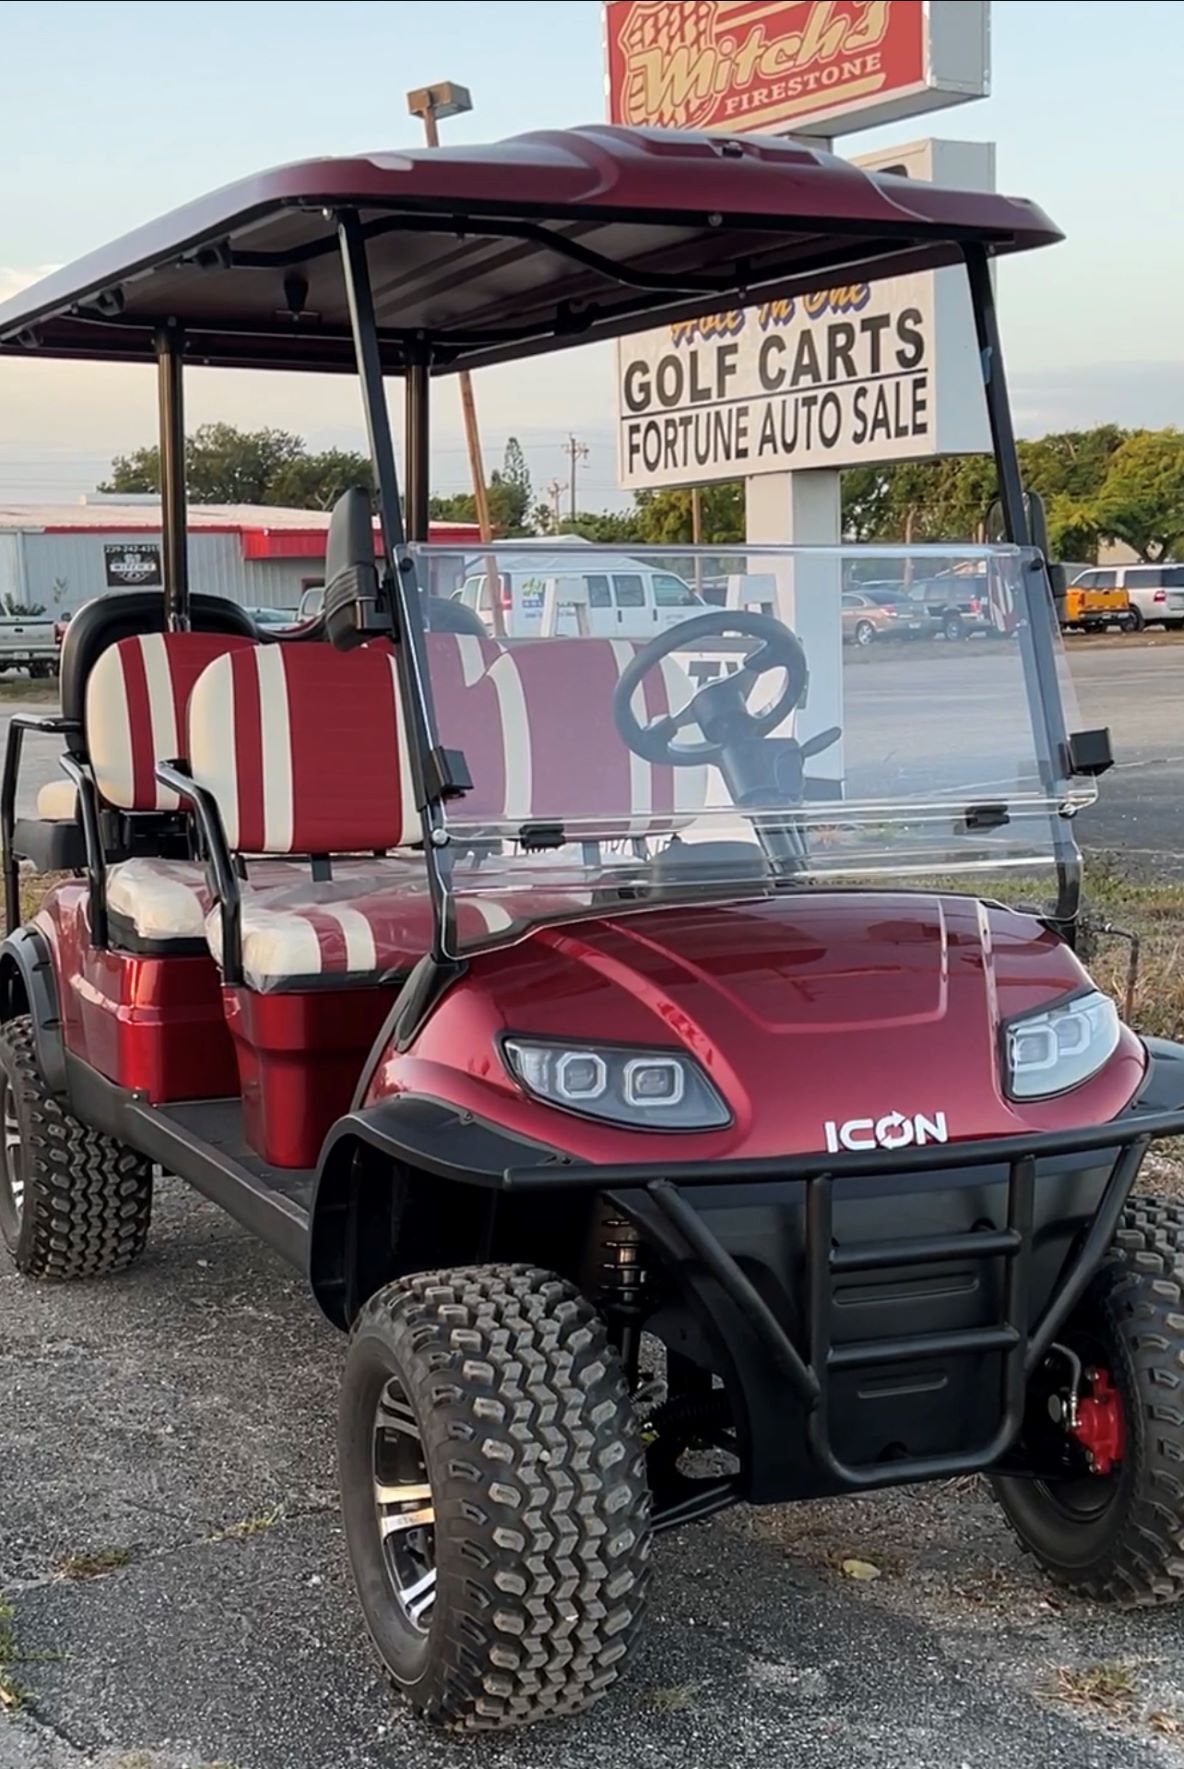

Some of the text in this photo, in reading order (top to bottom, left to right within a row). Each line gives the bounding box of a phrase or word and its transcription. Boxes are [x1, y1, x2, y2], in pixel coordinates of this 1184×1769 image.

[628, 1, 891, 116] Mitchs
[725, 52, 881, 115] FIRESTONE
[624, 308, 925, 413] GOLF CARTS
[629, 376, 928, 474] FORTUNE AUTO SALE
[825, 1111, 948, 1153] ICON
